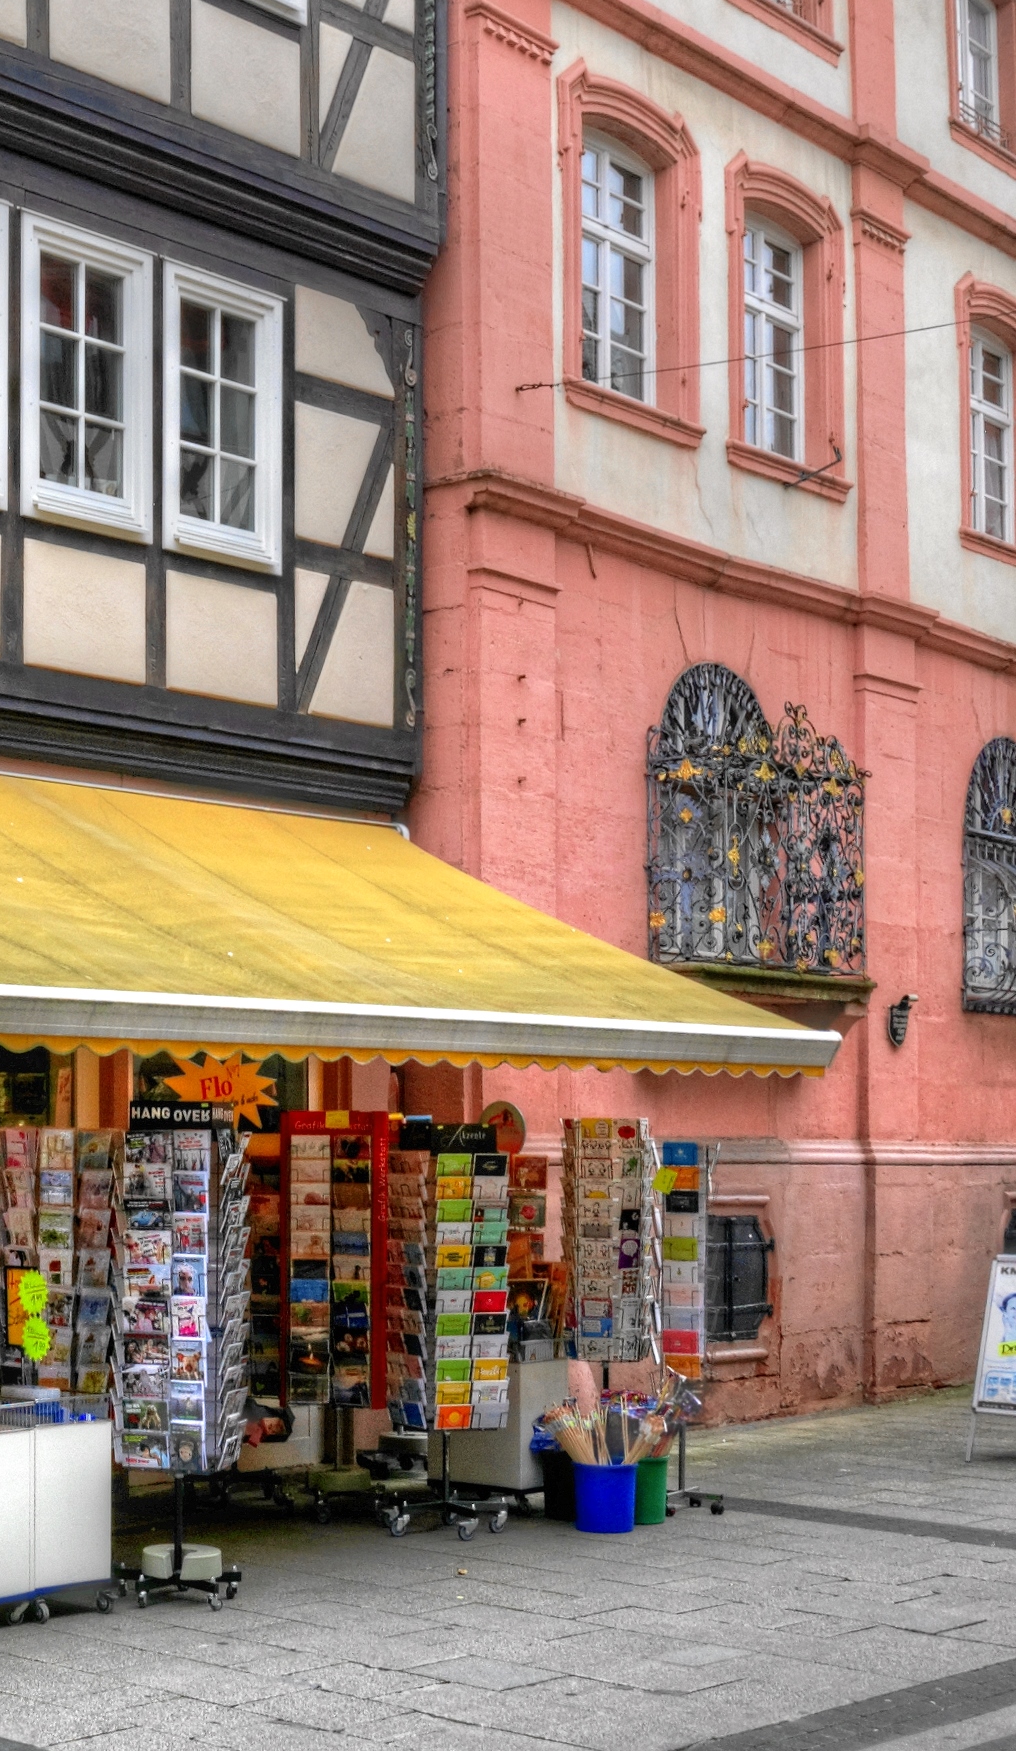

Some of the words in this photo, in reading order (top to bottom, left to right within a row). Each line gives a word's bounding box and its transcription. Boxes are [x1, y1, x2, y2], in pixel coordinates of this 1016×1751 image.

[200, 1076, 232, 1100] Flo
[131, 1105, 171, 1120] HANG
[173, 1109, 211, 1123] OVER
